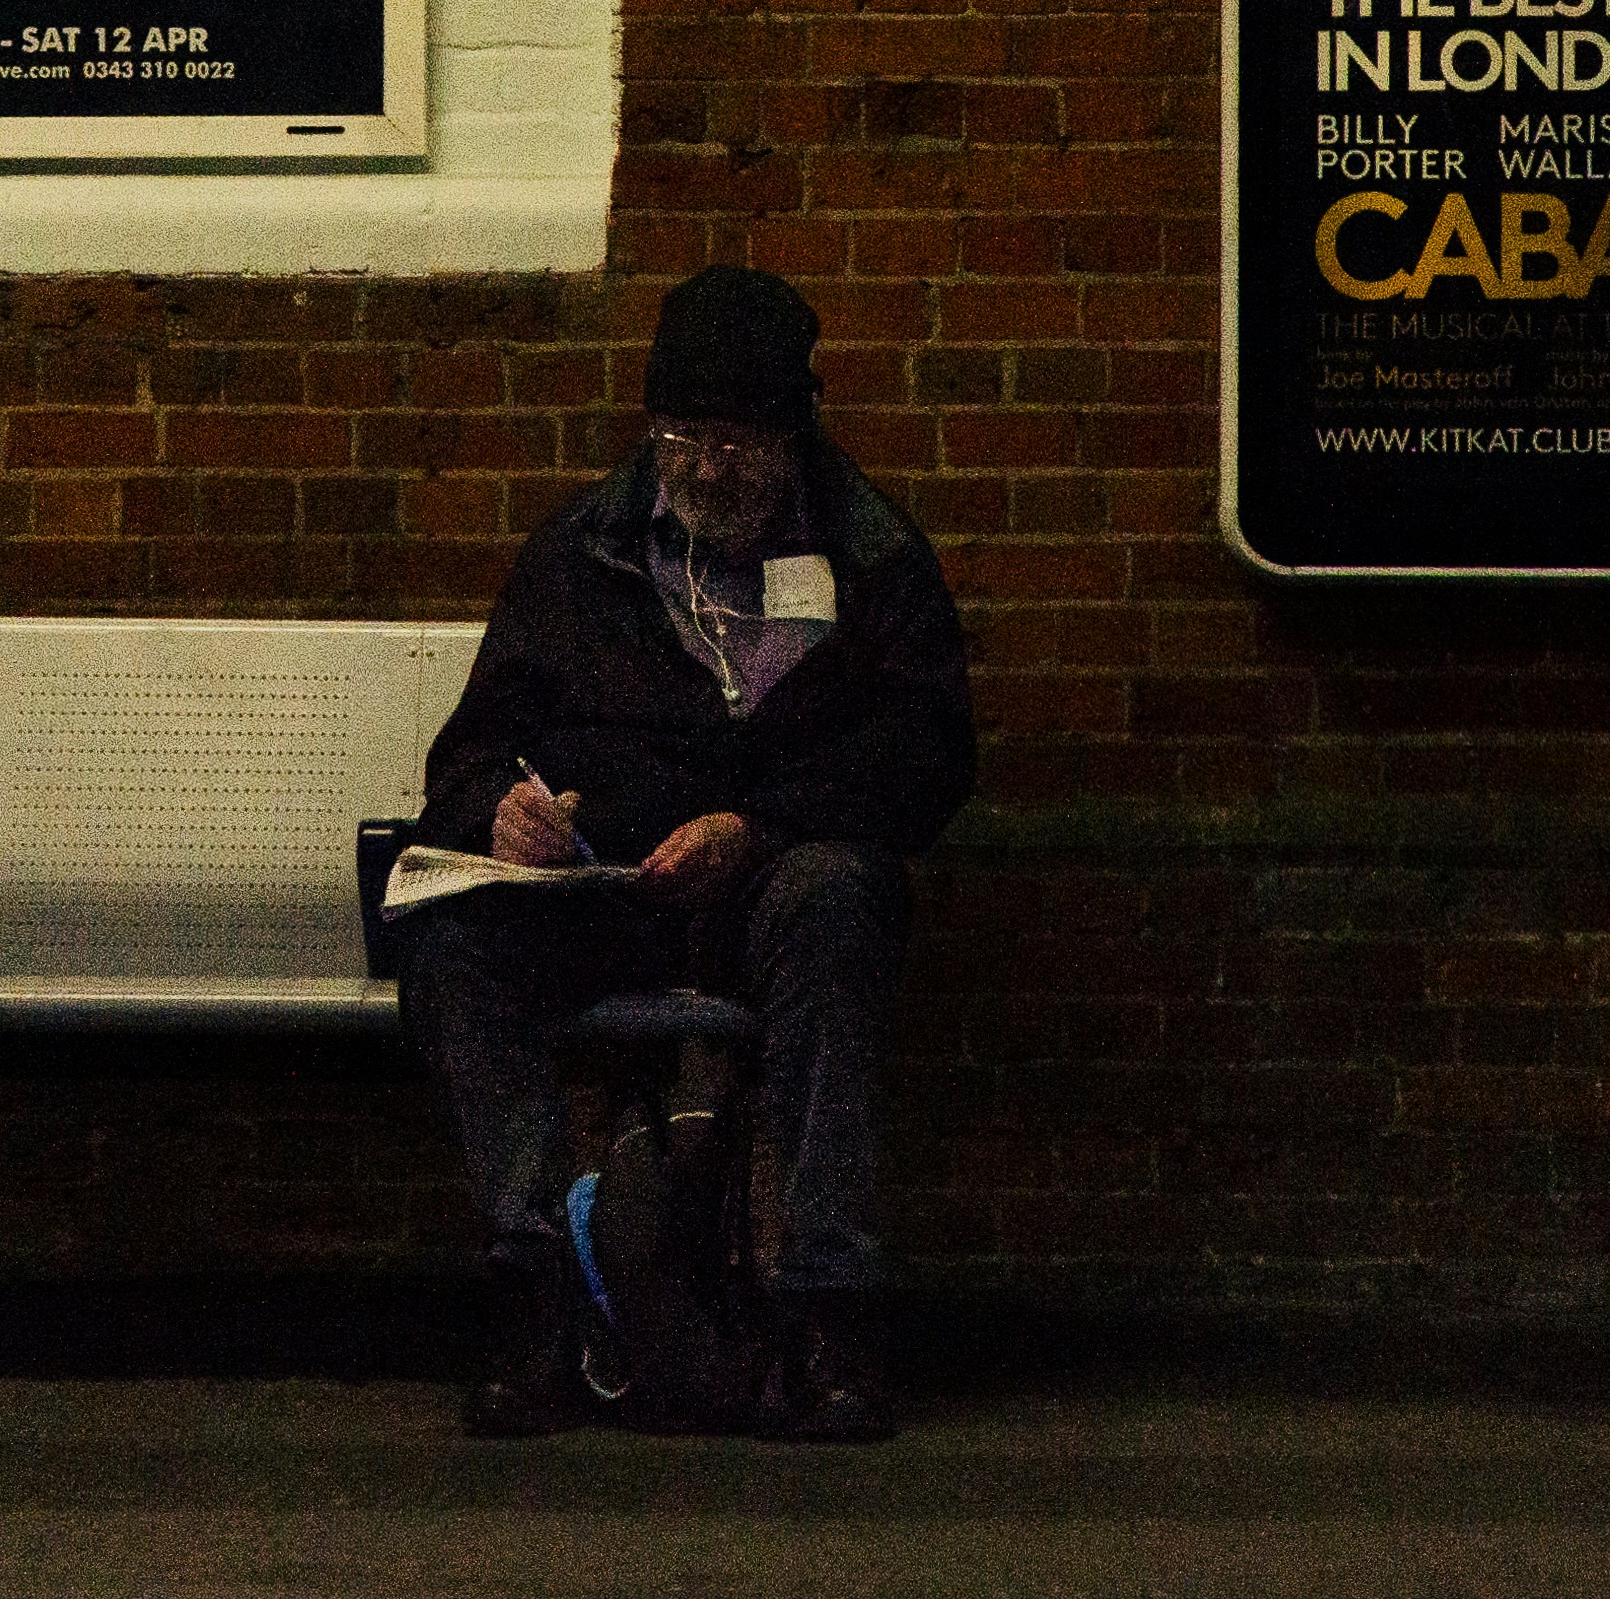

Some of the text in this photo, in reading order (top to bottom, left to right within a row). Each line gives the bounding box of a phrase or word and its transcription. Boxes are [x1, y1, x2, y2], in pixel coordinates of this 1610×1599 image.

[22, 27, 80, 53] SAT
[95, 27, 131, 52] 12
[143, 27, 208, 52] APR
[83, 61, 133, 78] 0343
[141, 62, 178, 78] 310
[185, 62, 234, 79] 0022
[1318, 30, 1389, 92] IN
[1317, 115, 1419, 144] BILLY
[1317, 151, 1466, 180] PORTER
[1317, 313, 1381, 340] THE
[1390, 313, 1539, 340] MUSICAL
[1554, 313, 1595, 340] AT
[1316, 363, 1513, 390] Joe Masteroff
